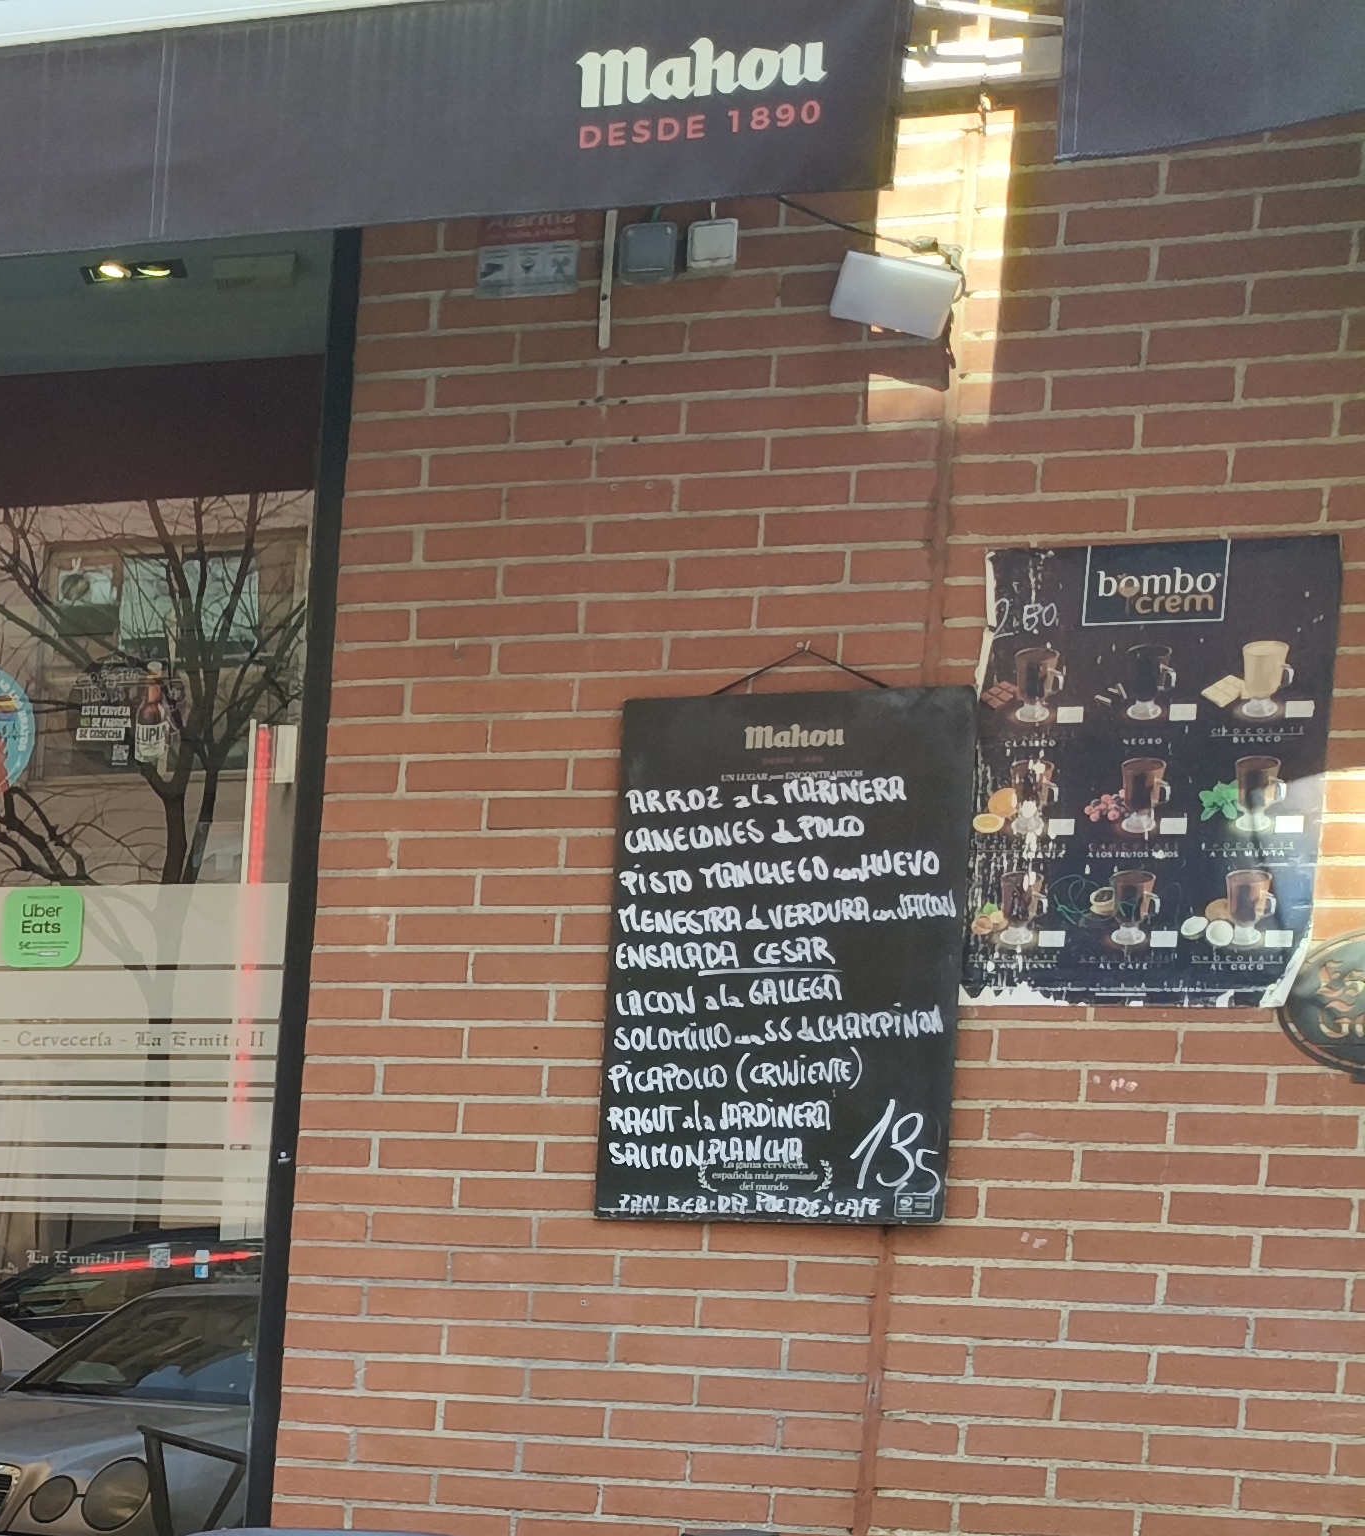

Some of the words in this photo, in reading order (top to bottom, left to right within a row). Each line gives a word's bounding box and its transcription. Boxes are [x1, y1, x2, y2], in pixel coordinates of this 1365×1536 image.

[576, 37, 827, 109] Mahou
[579, 115, 706, 149] DESDE
[729, 100, 822, 134] 1890
[1098, 567, 1220, 597] bombo
[1135, 594, 1214, 613] crem
[744, 724, 845, 749] Mahou
[625, 786, 723, 814] ARROZ
[783, 776, 906, 805] MARINERA
[624, 819, 764, 853] CANELONES
[619, 864, 692, 895] PISTO
[700, 856, 829, 888] MANCHEGO
[860, 850, 940, 877] HUEVO
[22, 903, 63, 918] Uber
[618, 903, 742, 934] MENESTRA
[768, 897, 870, 930] VERDURA
[21, 920, 61, 934] Eats
[616, 941, 739, 969] ENSALADA
[754, 937, 835, 964] CESAR
[616, 986, 696, 1016] LACON
[749, 974, 843, 1005] GALLEGA
[16, 1031, 113, 1048] Cervecería
[135, 1031, 162, 1049] La
[613, 1023, 731, 1052] SOLOMILLO
[608, 1060, 728, 1093] PICAPOLLO
[607, 1104, 682, 1135] RAGUT
[719, 1098, 831, 1132] JARDINERA
[611, 1139, 705, 1169] SALMON
[712, 1171, 752, 1181] española
[739, 1182, 752, 1191] del
[755, 1182, 789, 1191] mundo
